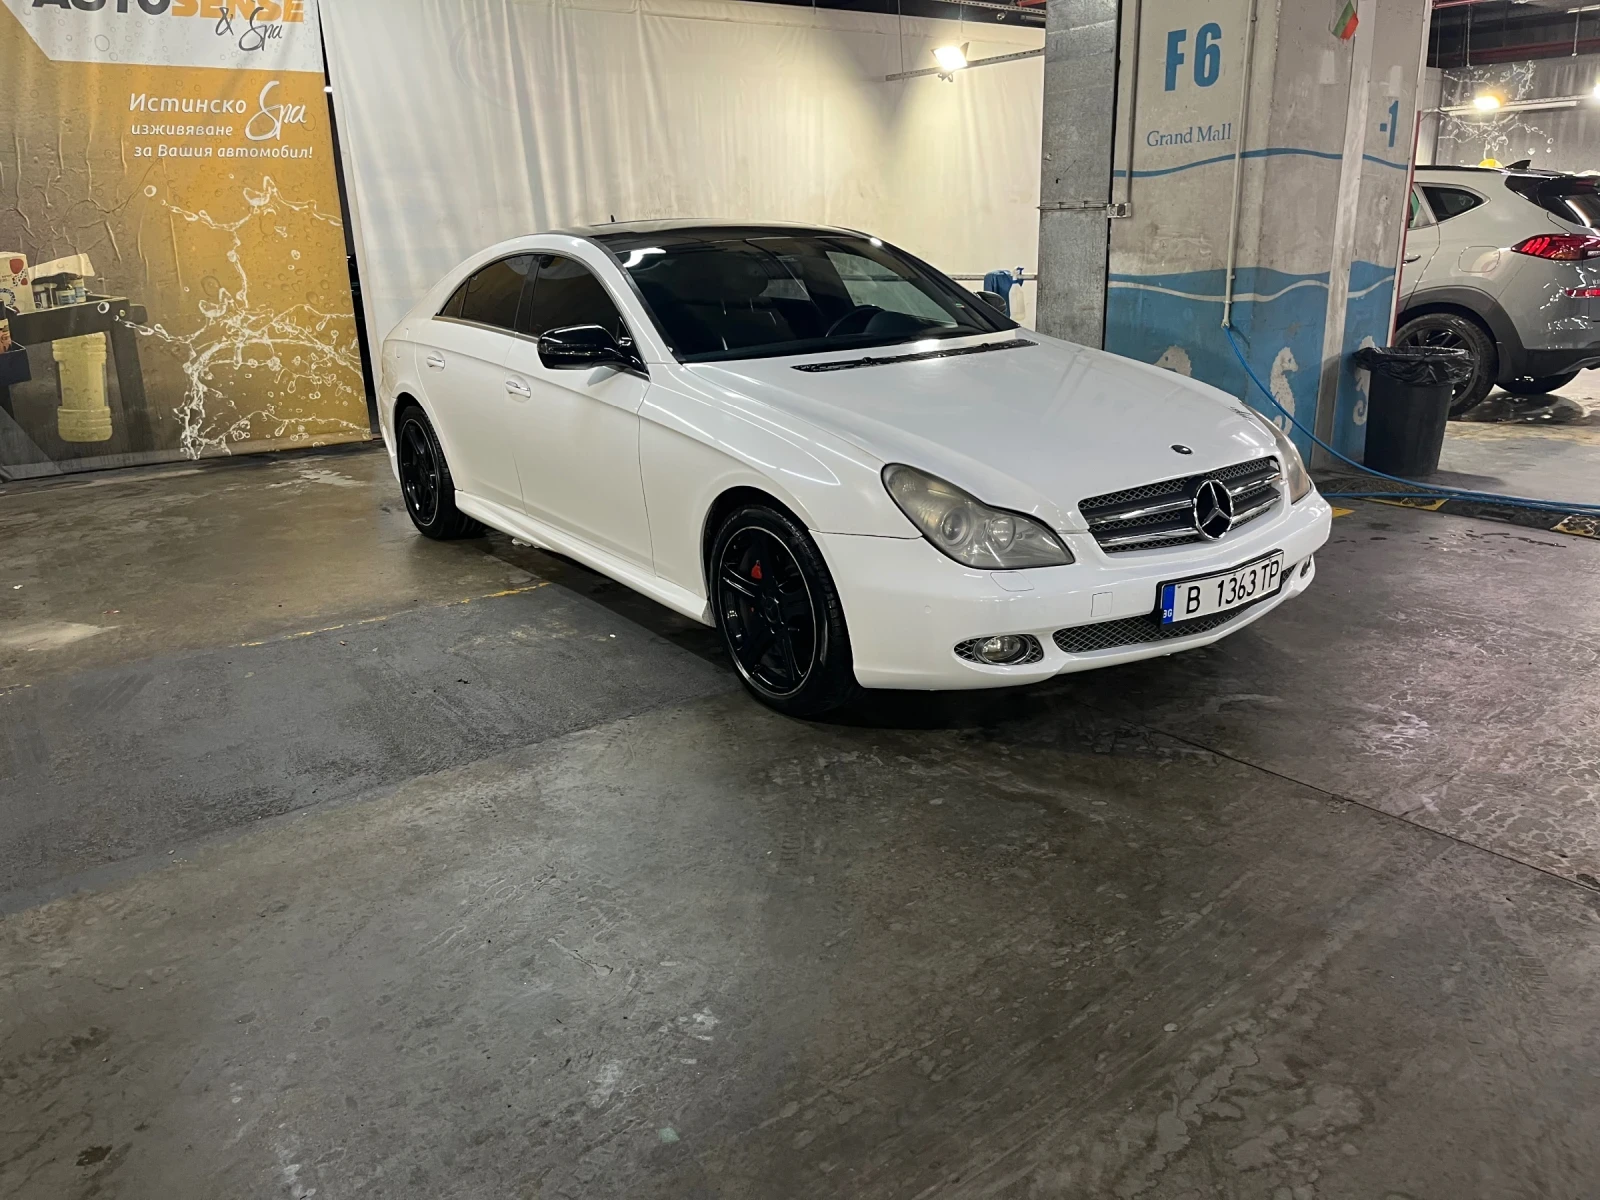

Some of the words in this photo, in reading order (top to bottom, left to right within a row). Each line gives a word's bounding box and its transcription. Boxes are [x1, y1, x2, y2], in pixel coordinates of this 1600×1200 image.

[32, 0, 304, 22] OSENSE
[215, 7, 234, 36] &
[238, 6, 283, 51] Spa
[129, 93, 247, 113] Истинско
[245, 80, 307, 141] Spa
[131, 123, 233, 137] изживяване
[1147, 126, 1193, 147] Grand
[1197, 122, 1232, 143] Mall
[1379, 100, 1399, 148] -1
[134, 146, 152, 157] за
[158, 144, 212, 158] Вашия
[218, 145, 313, 159] автомобил!
[1217, 569, 1257, 607] 1363
